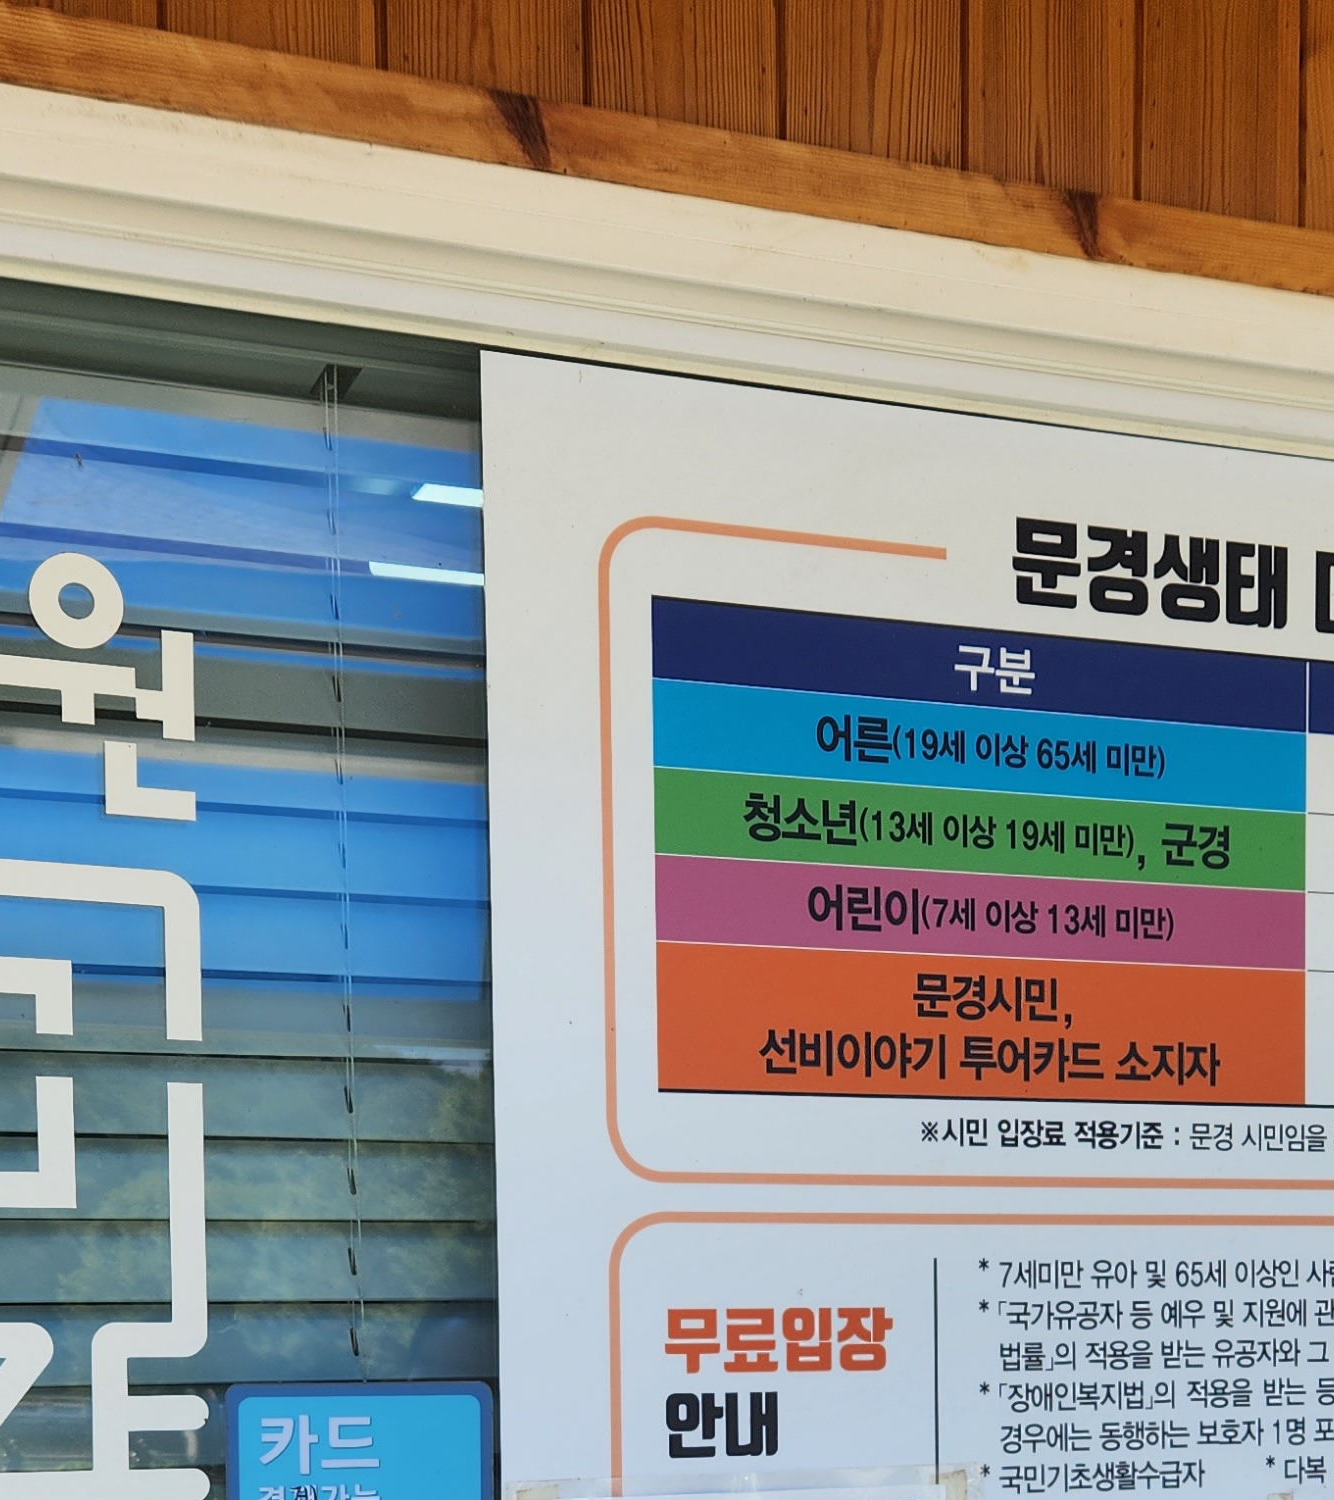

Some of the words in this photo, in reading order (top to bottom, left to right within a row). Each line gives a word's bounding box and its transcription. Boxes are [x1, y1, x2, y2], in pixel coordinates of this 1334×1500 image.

[1012, 516, 1288, 630] 문경생태
[954, 644, 1036, 696] 구분
[816, 714, 967, 766] 어른(19세
[976, 735, 1029, 771] 이상
[1036, 736, 1098, 776] 65세
[1105, 741, 1167, 780] 미만)
[743, 792, 934, 849] 청소년(13세
[942, 813, 999, 851] 이상
[1005, 816, 1067, 855] 19세
[1160, 822, 1232, 870] 군경
[807, 883, 977, 936] 어린이(7세
[985, 899, 1039, 936] 이상
[1047, 902, 1107, 941] 13세
[1115, 905, 1175, 944] 미만)
[912, 972, 1073, 1029] 문경시민,
[758, 1029, 947, 1081] 선비이야기
[959, 1035, 1105, 1085] 투어카드
[1114, 1040, 1221, 1087] 소지자
[997, 1117, 1066, 1148] 입장료
[1074, 1119, 1164, 1150] 적용기준
[1189, 1121, 1234, 1152] 문경
[1241, 1122, 1327, 1153] 시민임을
[999, 1259, 1084, 1290] 7세미만
[1090, 1259, 1138, 1289] 유아
[1175, 1260, 1227, 1289] 65세
[1235, 1259, 1300, 1288] 이상인
[665, 1307, 894, 1374] 무료입장
[1161, 1300, 1206, 1329] 예우
[1242, 1298, 1307, 1328] 지원에
[1085, 1340, 1153, 1371] 적용을
[1161, 1340, 1206, 1370] 받는
[1212, 1338, 1301, 1368] 유공자와
[1186, 1378, 1253, 1409] 적용을
[1263, 1377, 1307, 1407] 받는
[259, 1414, 381, 1476] 카드
[665, 1391, 779, 1459] 안내
[999, 1421, 1092, 1455] 경우에는
[1099, 1418, 1190, 1451] 동행하는
[1197, 1417, 1264, 1448] 보호자
[999, 1457, 1206, 1494] 국민기초생활수급자
[1284, 1454, 1327, 1485] 다복
